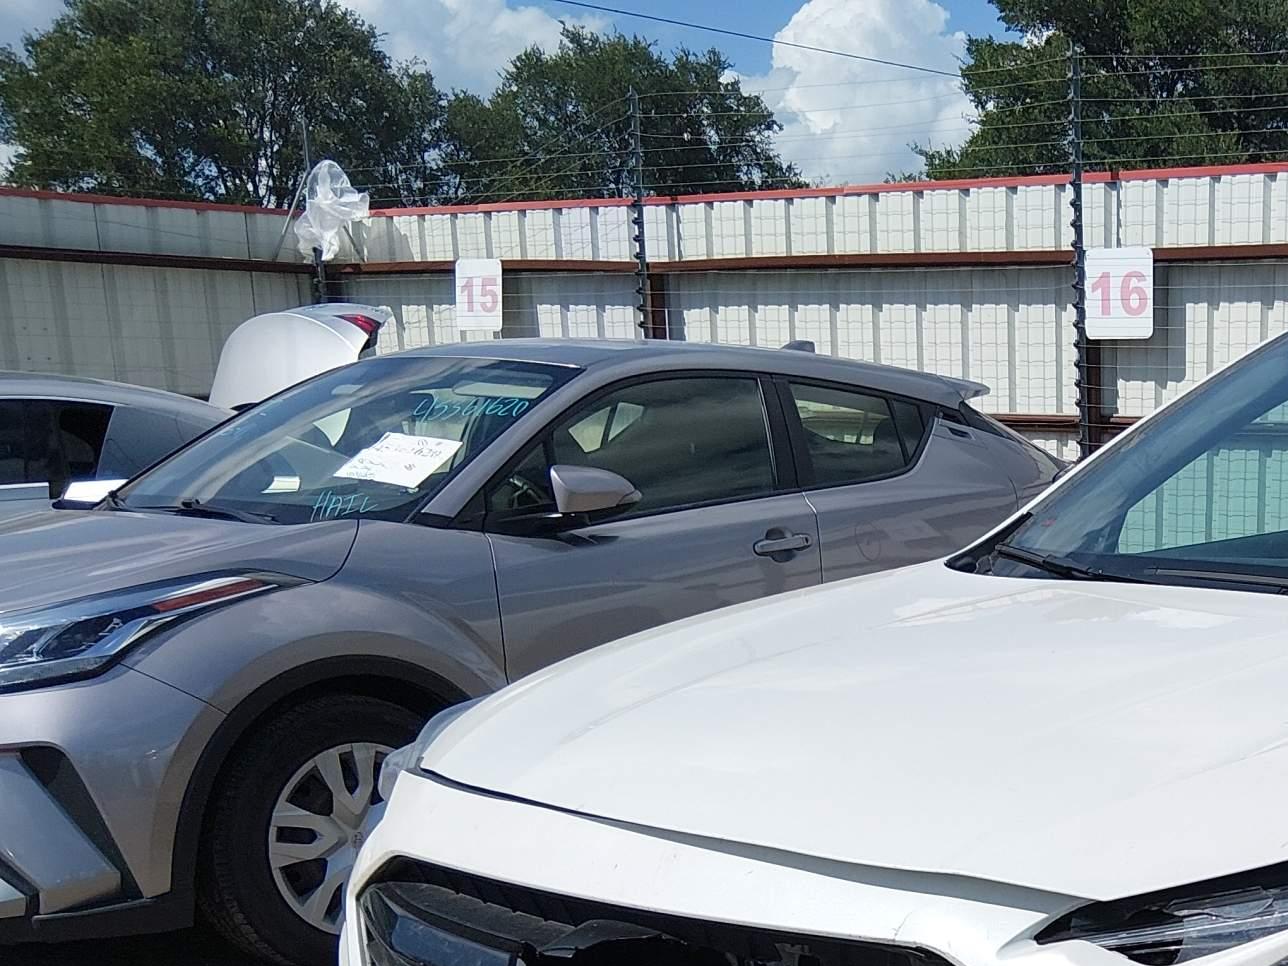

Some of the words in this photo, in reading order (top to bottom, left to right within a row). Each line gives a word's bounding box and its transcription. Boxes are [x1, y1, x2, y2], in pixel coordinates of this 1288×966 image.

[461, 276, 498, 313] 15
[1091, 270, 1148, 316] 16
[310, 490, 379, 522] HAIL
